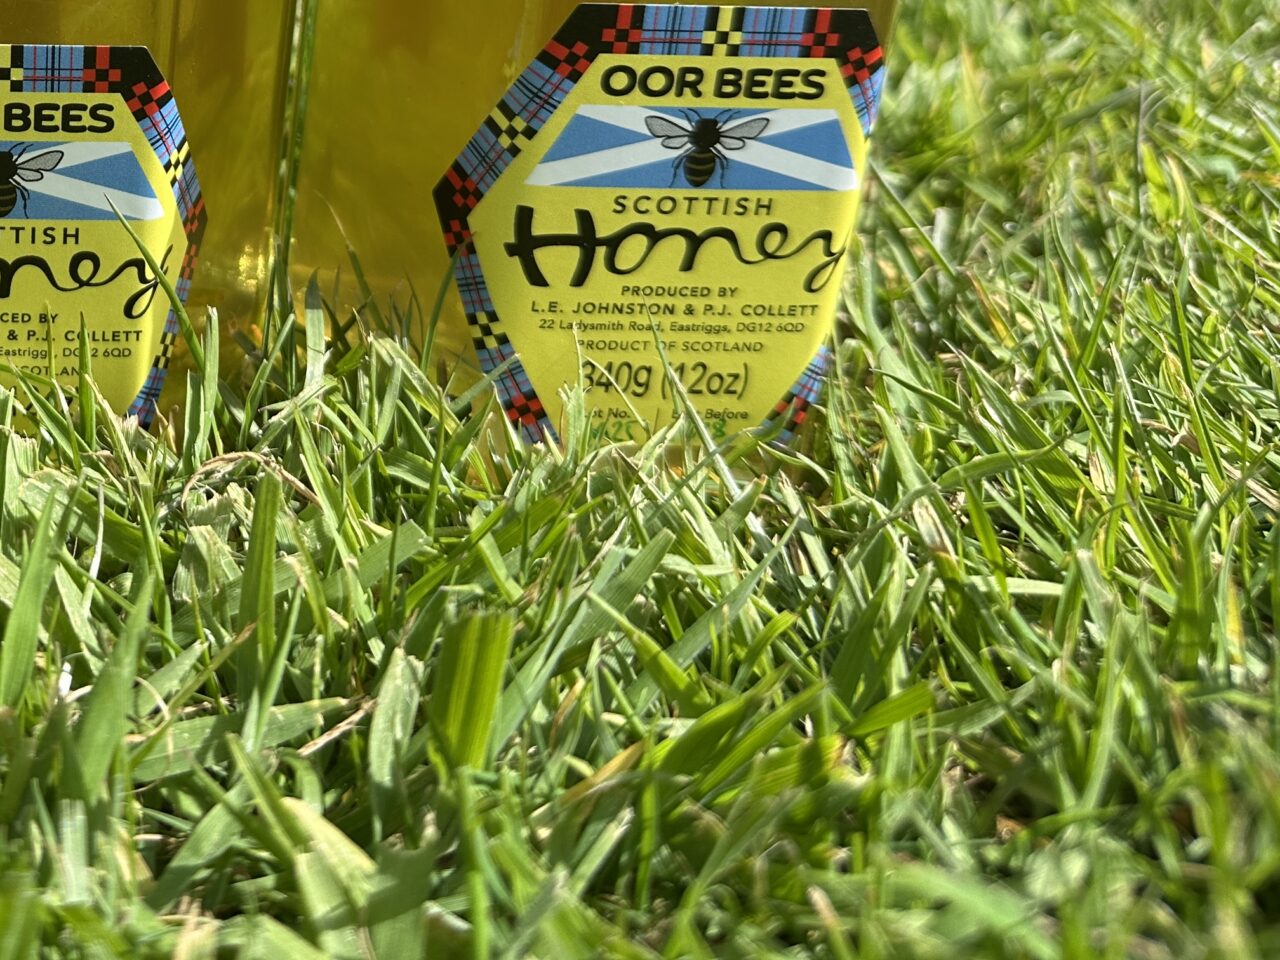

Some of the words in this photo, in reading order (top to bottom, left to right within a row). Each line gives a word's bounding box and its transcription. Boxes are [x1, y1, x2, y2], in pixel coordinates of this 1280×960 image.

[600, 64, 704, 99] OOR
[713, 67, 827, 100] BEES
[3, 102, 115, 134] BEES
[611, 194, 774, 216] SCOTTISH
[503, 204, 847, 294] Honey
[621, 285, 711, 298] PRODUCED
[717, 286, 738, 298] BY
[531, 300, 564, 313] L.E.
[572, 301, 675, 315] JOHNSTON
[683, 303, 695, 316] &
[703, 304, 732, 316] P.J.
[740, 304, 819, 317] COLLETT
[38, 313, 59, 324] BY
[538, 318, 555, 329] 22
[559, 319, 624, 332] Ladysmith
[628, 321, 665, 333] Road,
[669, 321, 731, 334] Eastriggs,
[736, 322, 772, 333] DG12
[776, 322, 805, 333] 6QD
[6, 329, 19, 341] &
[27, 329, 56, 341] P.J.
[62, 347, 98, 358] DG2
[102, 347, 132, 358] 6QD
[578, 339, 651, 351] PRODUCT
[681, 341, 764, 352] SCOTLAND
[581, 360, 653, 398] 340g
[661, 360, 749, 401] (12oz)
[704, 407, 749, 420] Before
